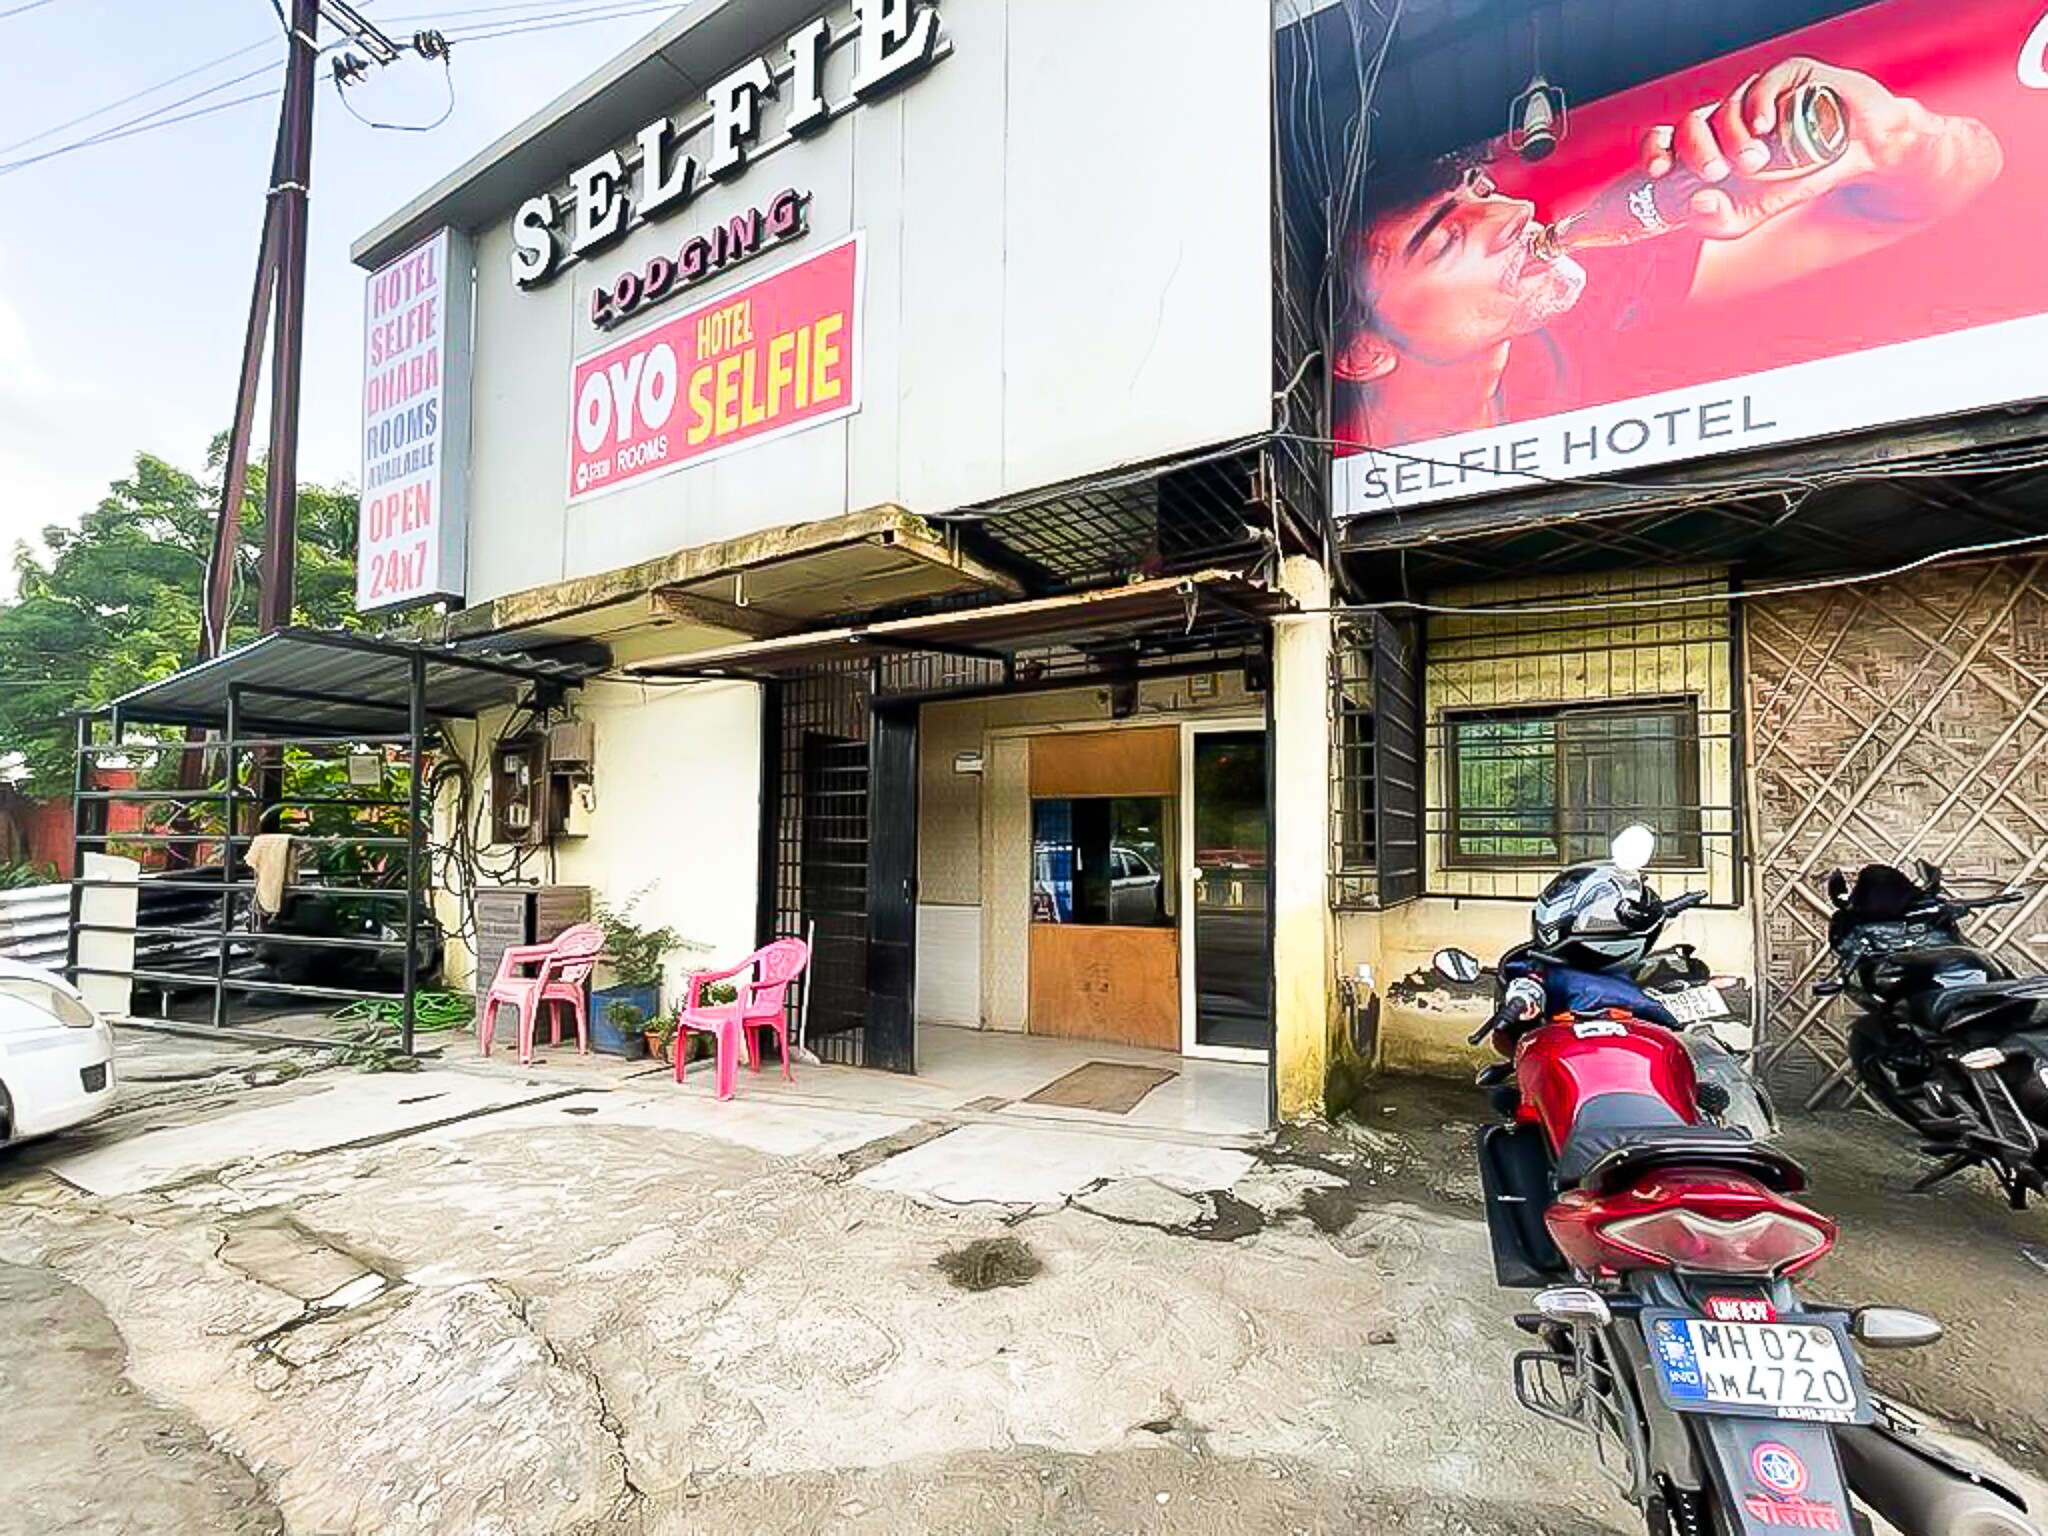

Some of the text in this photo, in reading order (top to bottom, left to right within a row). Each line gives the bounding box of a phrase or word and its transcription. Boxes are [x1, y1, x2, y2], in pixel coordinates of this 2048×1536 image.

[511, 0, 938, 287] SELFIE
[373, 247, 437, 318] HOTEL
[592, 188, 806, 325] LODGING
[371, 296, 437, 367] SELFIE
[697, 298, 754, 361] HOTEL
[368, 346, 438, 418] DHABA
[576, 343, 678, 453] OYO
[686, 312, 844, 446] SELFIE
[367, 398, 437, 461] ROOMS
[617, 434, 668, 472] ROOMS
[1363, 395, 1776, 499] SELFIE HOTEL
[368, 442, 435, 490] AVAILABLE
[369, 479, 431, 543] OPEN
[1699, 1325, 1815, 1363] MH 02
[1747, 1366, 1850, 1404] 4720
